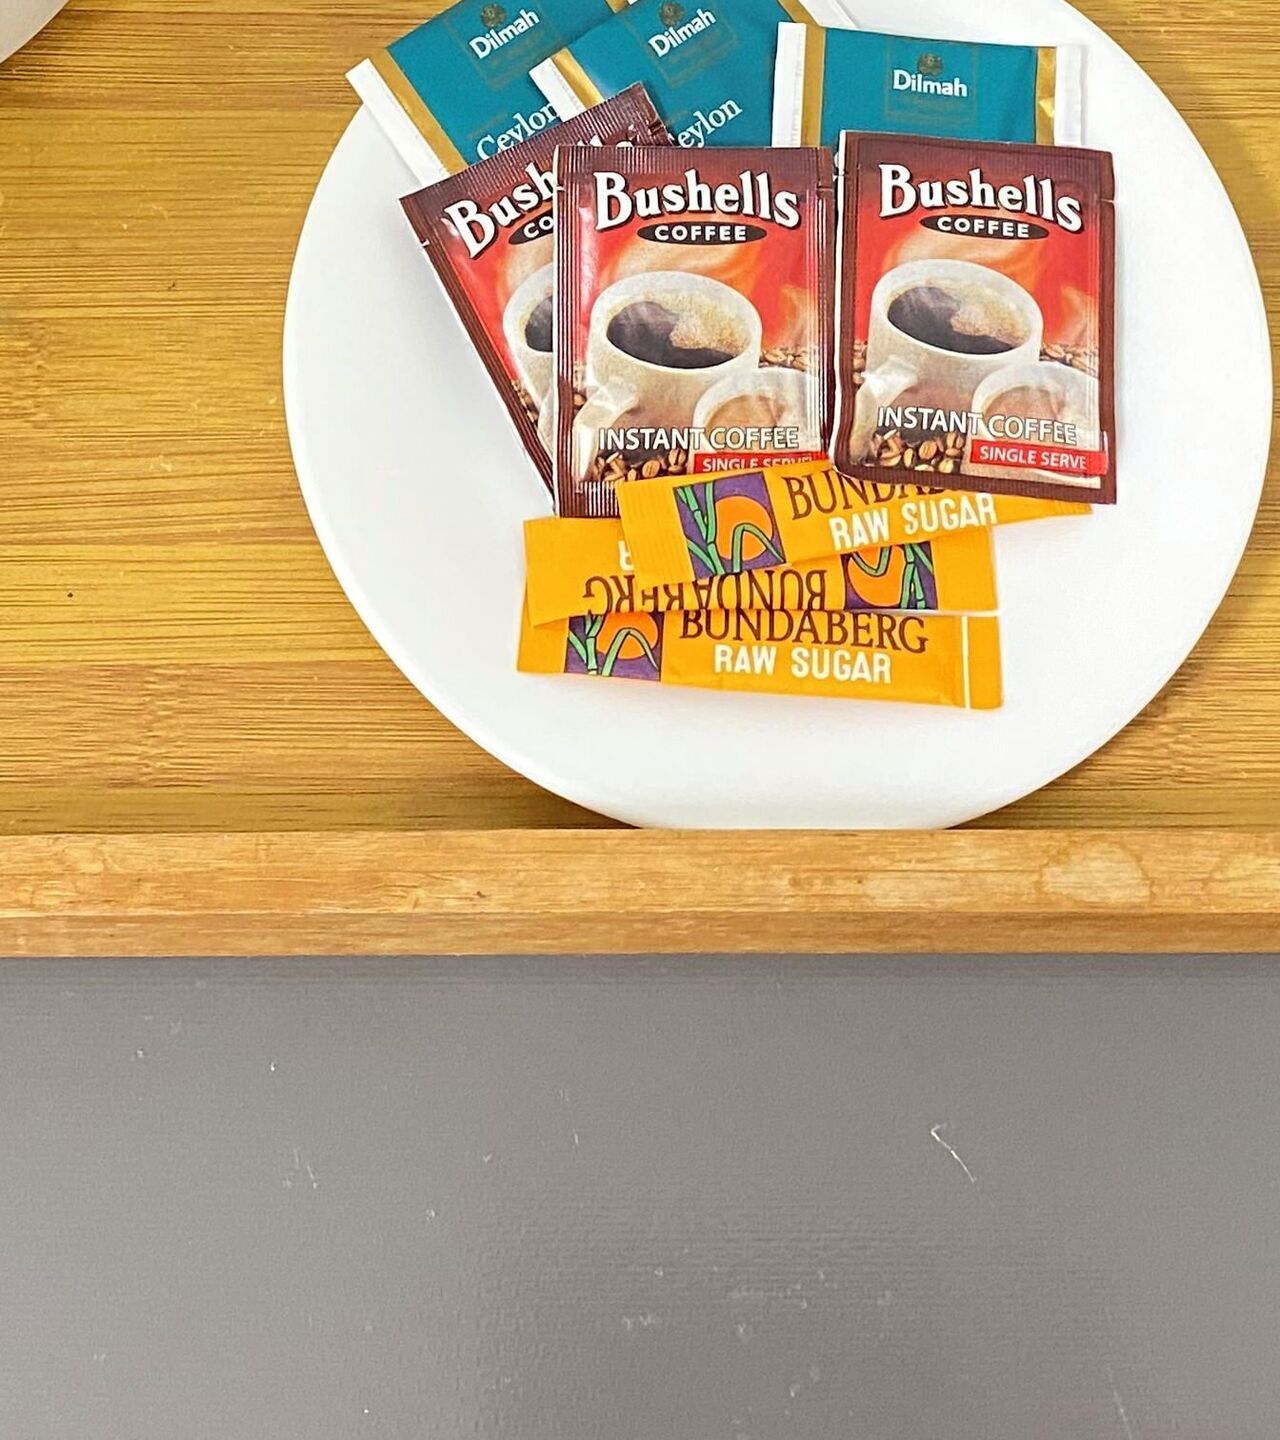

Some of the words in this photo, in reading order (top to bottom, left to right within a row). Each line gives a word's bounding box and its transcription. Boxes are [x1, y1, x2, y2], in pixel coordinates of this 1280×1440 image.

[468, 8, 540, 59] Dilmah
[648, 8, 717, 58] Dilmah
[892, 69, 968, 98] Dilmah
[668, 100, 743, 149] eylon
[592, 168, 801, 231] Bushells
[878, 163, 1084, 234] Bushells
[654, 225, 747, 241] COFFEE
[936, 216, 1030, 238] COFFEE
[599, 427, 704, 451] INSTANT
[709, 427, 799, 451] COFFEE
[878, 406, 983, 436] INSTANT
[987, 414, 1078, 445] COFFEE
[979, 446, 1037, 465] SINGLE
[1040, 451, 1088, 470] SERVE
[828, 513, 890, 552] RAW
[903, 493, 998, 539] SUGAR
[678, 607, 929, 655] BUNDABERG
[714, 644, 777, 675] RAW
[790, 646, 893, 685] SUGAR
